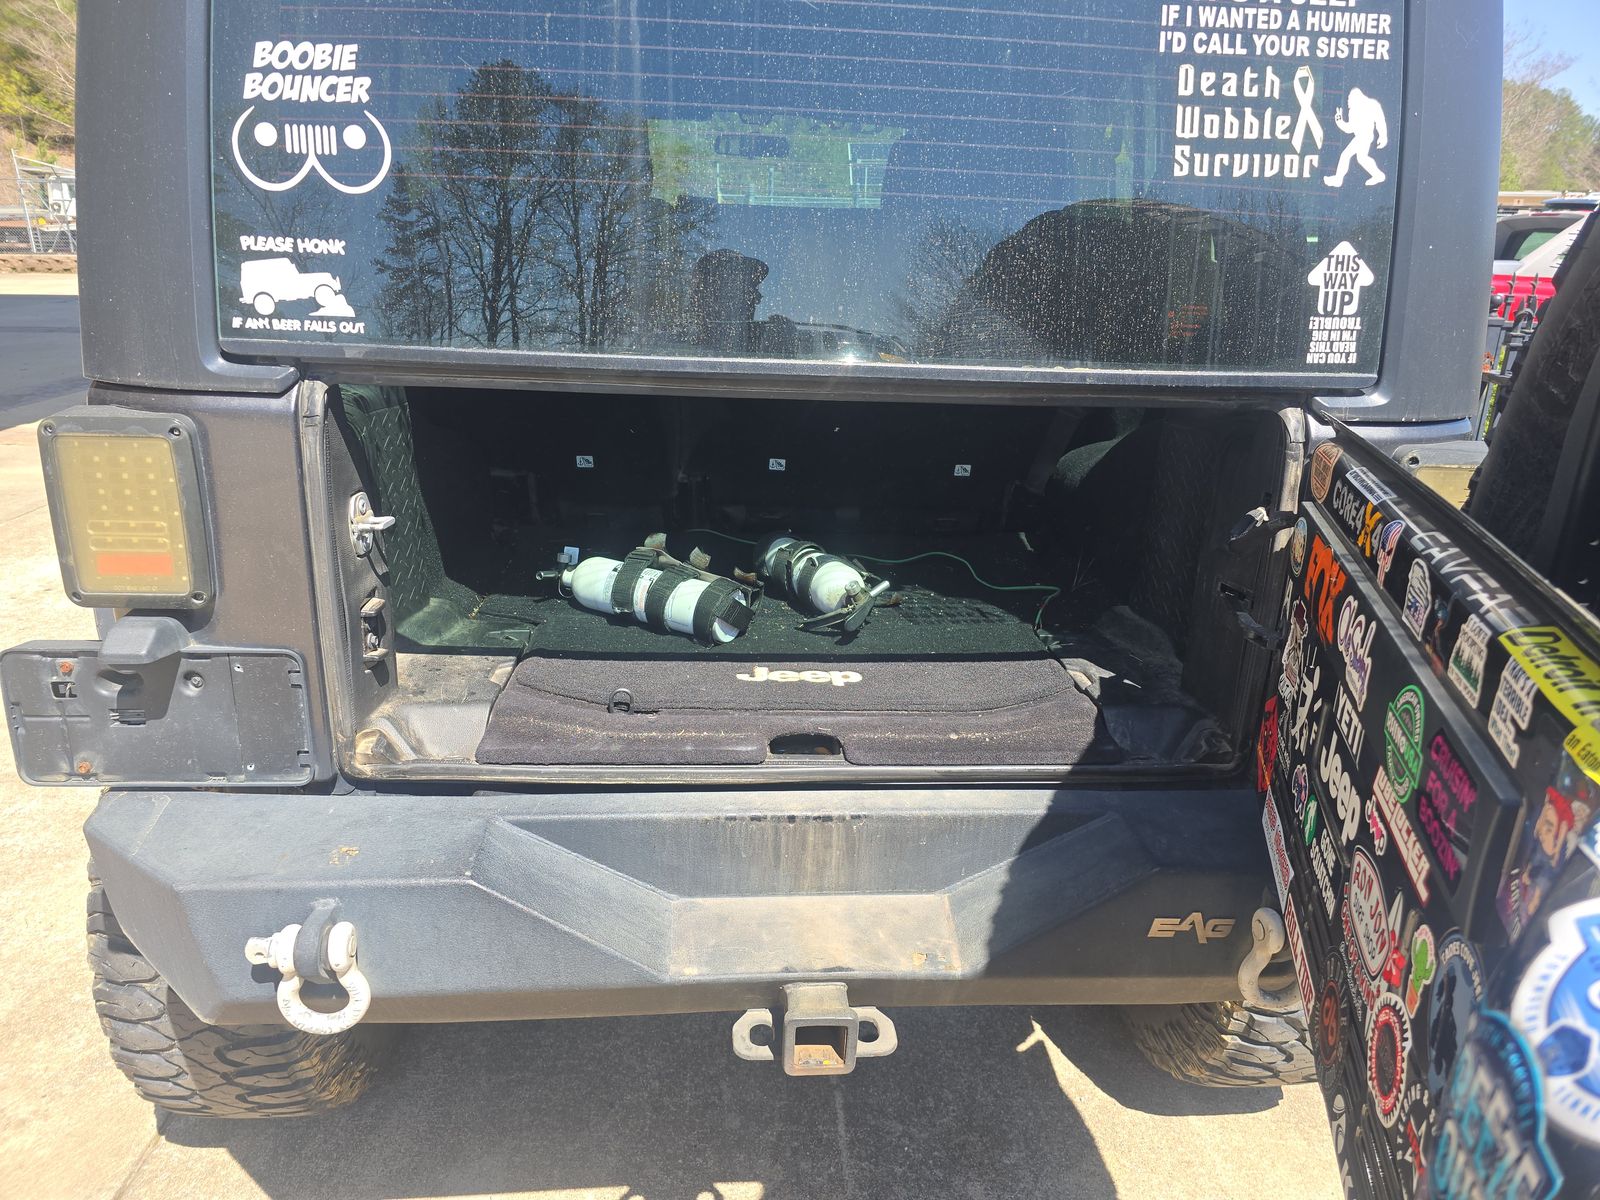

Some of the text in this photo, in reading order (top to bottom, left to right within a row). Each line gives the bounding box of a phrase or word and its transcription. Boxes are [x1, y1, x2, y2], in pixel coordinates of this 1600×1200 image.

[1161, 5, 1391, 34] IF I WANTED A HUMMER
[252, 40, 359, 71] BOOBIE
[1159, 31, 1390, 60] I'D CALL YOUR SISTER
[242, 73, 371, 104] BOUNCER
[1178, 64, 1280, 100] Death
[1175, 103, 1292, 140] Wobble
[1173, 144, 1319, 178] Survivor
[239, 235, 346, 255] PLEASE HONK
[1326, 254, 1360, 272] THIS
[1323, 272, 1359, 290] WAY
[1322, 291, 1353, 315] UP
[232, 316, 365, 334] IF ANY BEER FALLS OUT
[1312, 330, 1329, 341] BIG
[1330, 330, 1340, 341] IN
[1306, 353, 1357, 364] IF YOU CAN
[1310, 342, 1357, 353] READ THIS
[735, 665, 863, 687] Jeep
[1336, 684, 1363, 755] YETI
[1320, 730, 1361, 846] Jeep
[1353, 861, 1387, 956] RON JON
[1147, 912, 1236, 944] EAG
[1286, 899, 1314, 1020] ROLL TIDE
